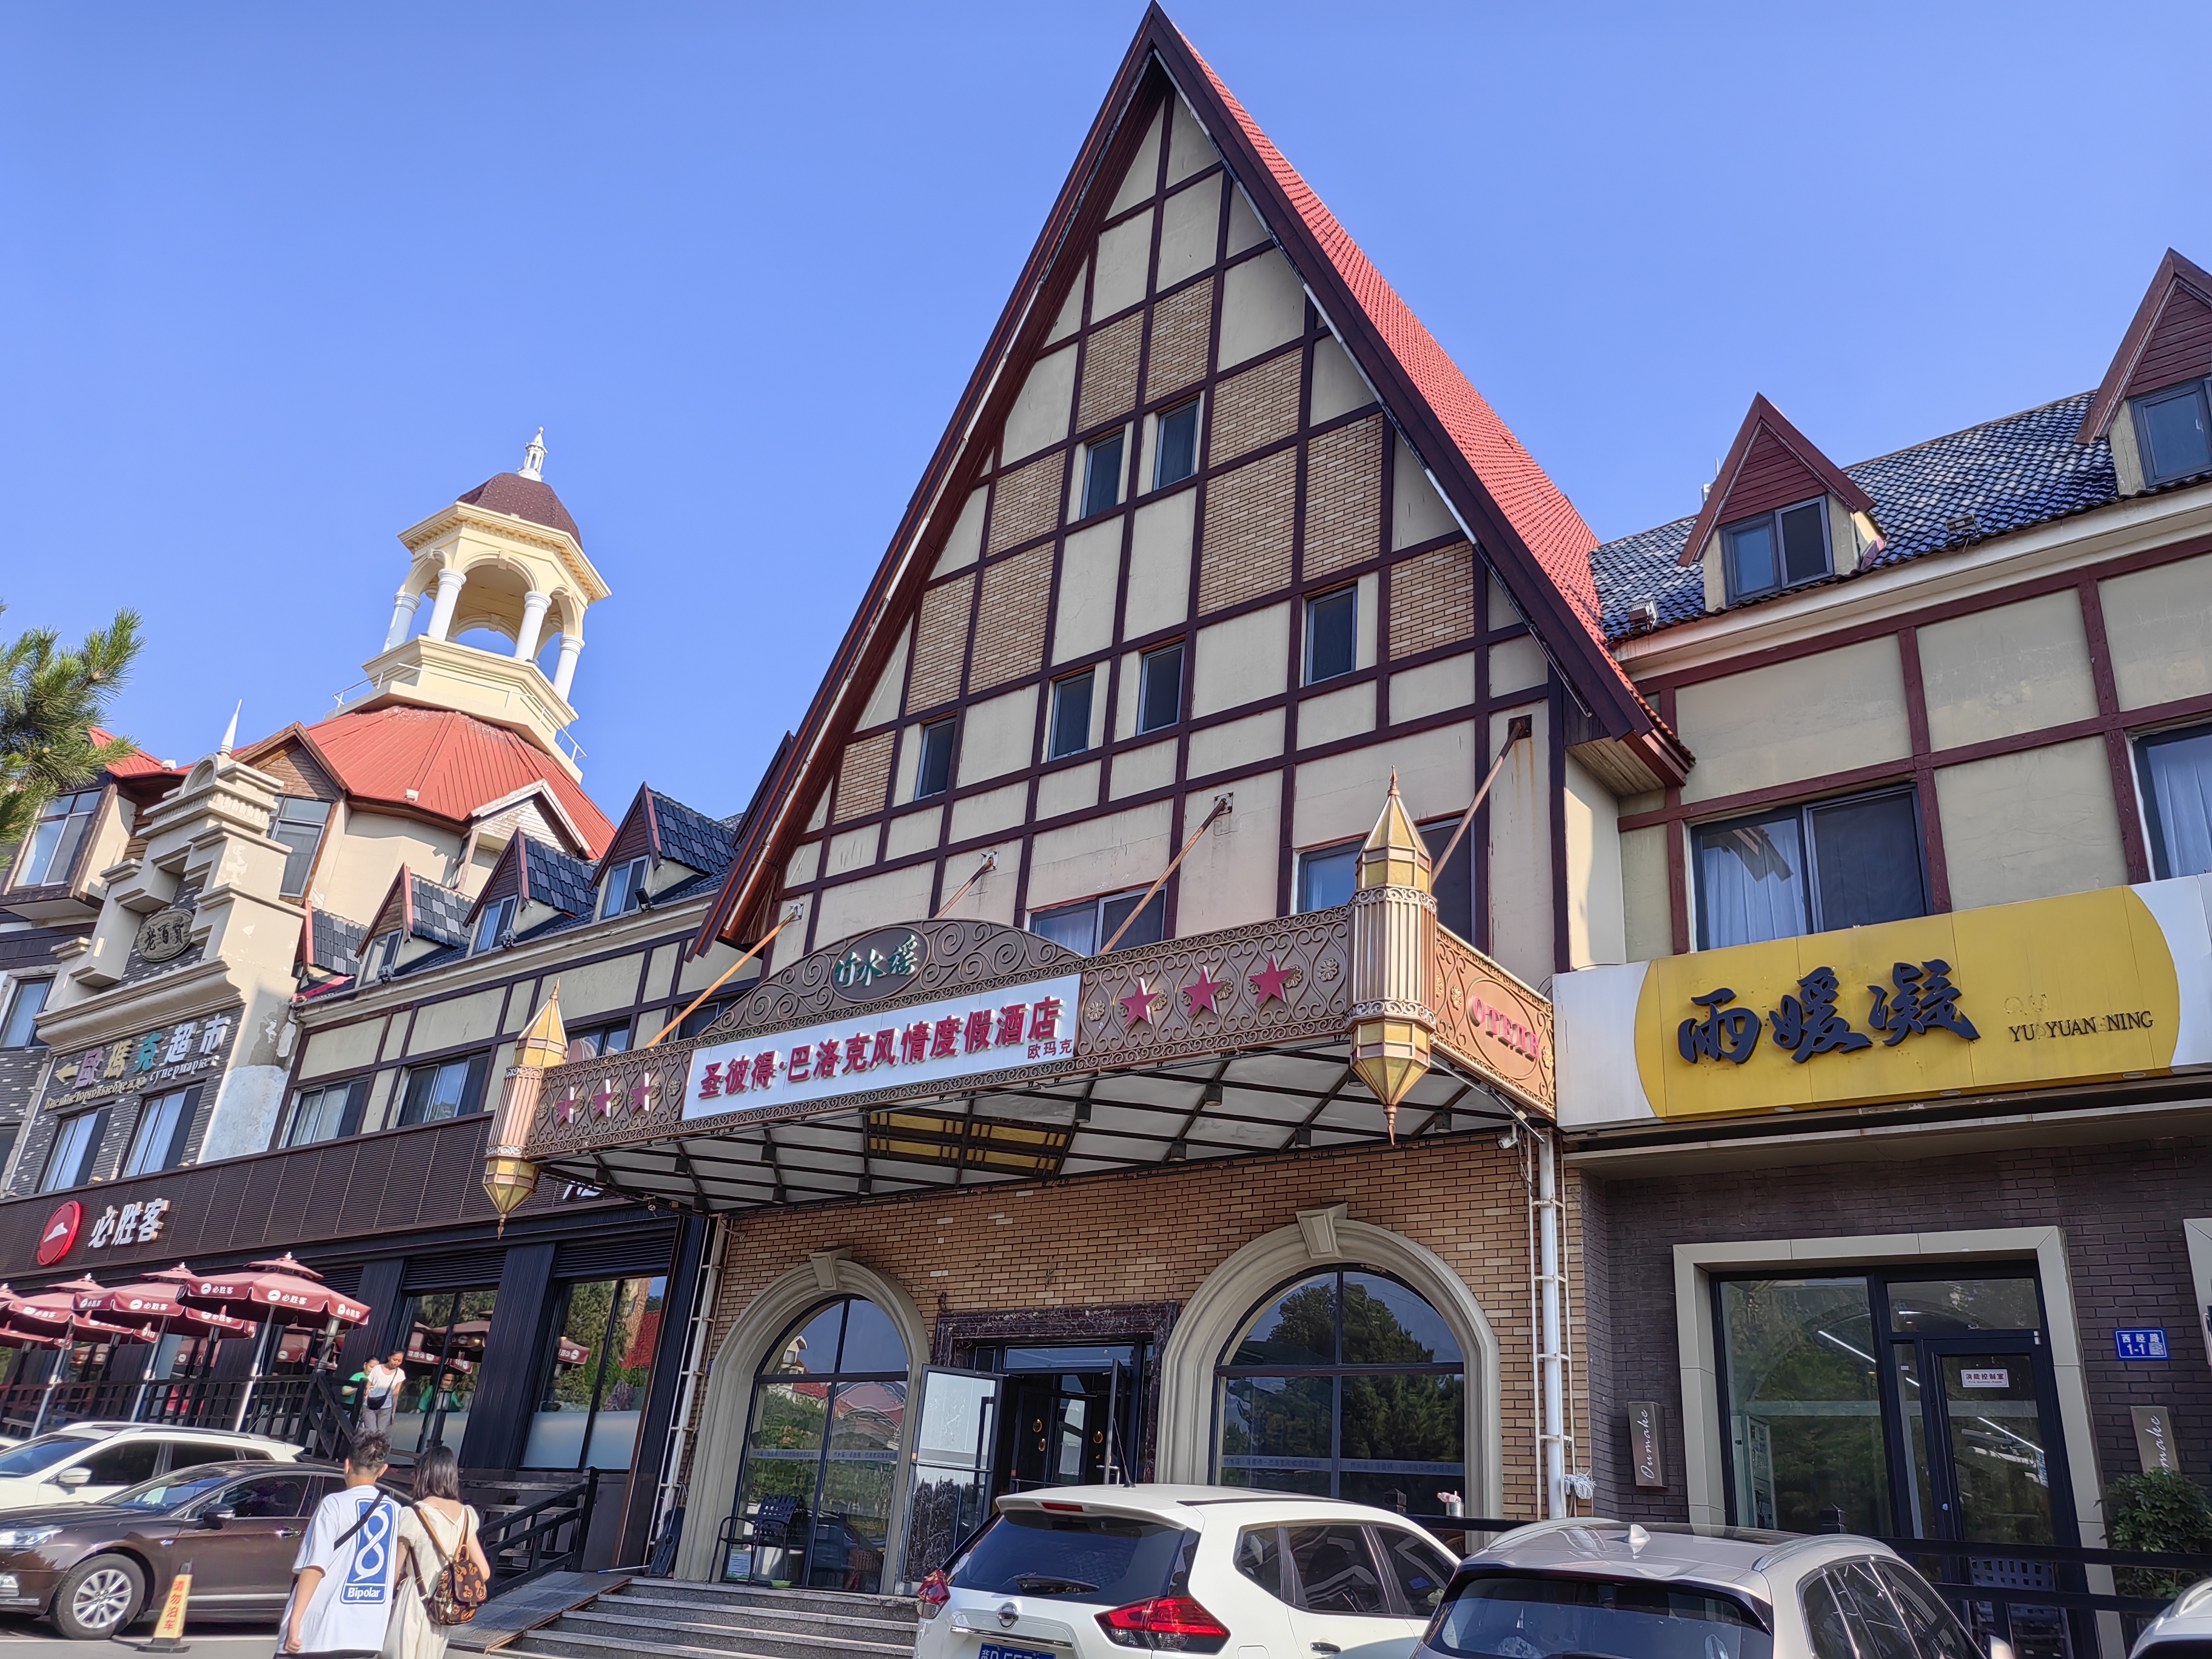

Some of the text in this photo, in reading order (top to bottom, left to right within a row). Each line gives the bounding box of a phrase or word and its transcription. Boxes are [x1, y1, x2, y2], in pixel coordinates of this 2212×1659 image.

[2009, 1011, 2154, 1042] YU YUAN NING
[699, 996, 1064, 1099] 圣彼得·巴洛克风情度假酒店
[1027, 1038, 1073, 1059] 欧玛克
[88, 1198, 171, 1248] 必胜客
[282, 1295, 307, 1305] 必胜客
[345, 1308, 360, 1318] 必胜客
[2127, 1344, 2145, 1355] 1-1
[347, 1587, 381, 1600] Bipolar
[163, 1580, 184, 1631] 请勿泊车
